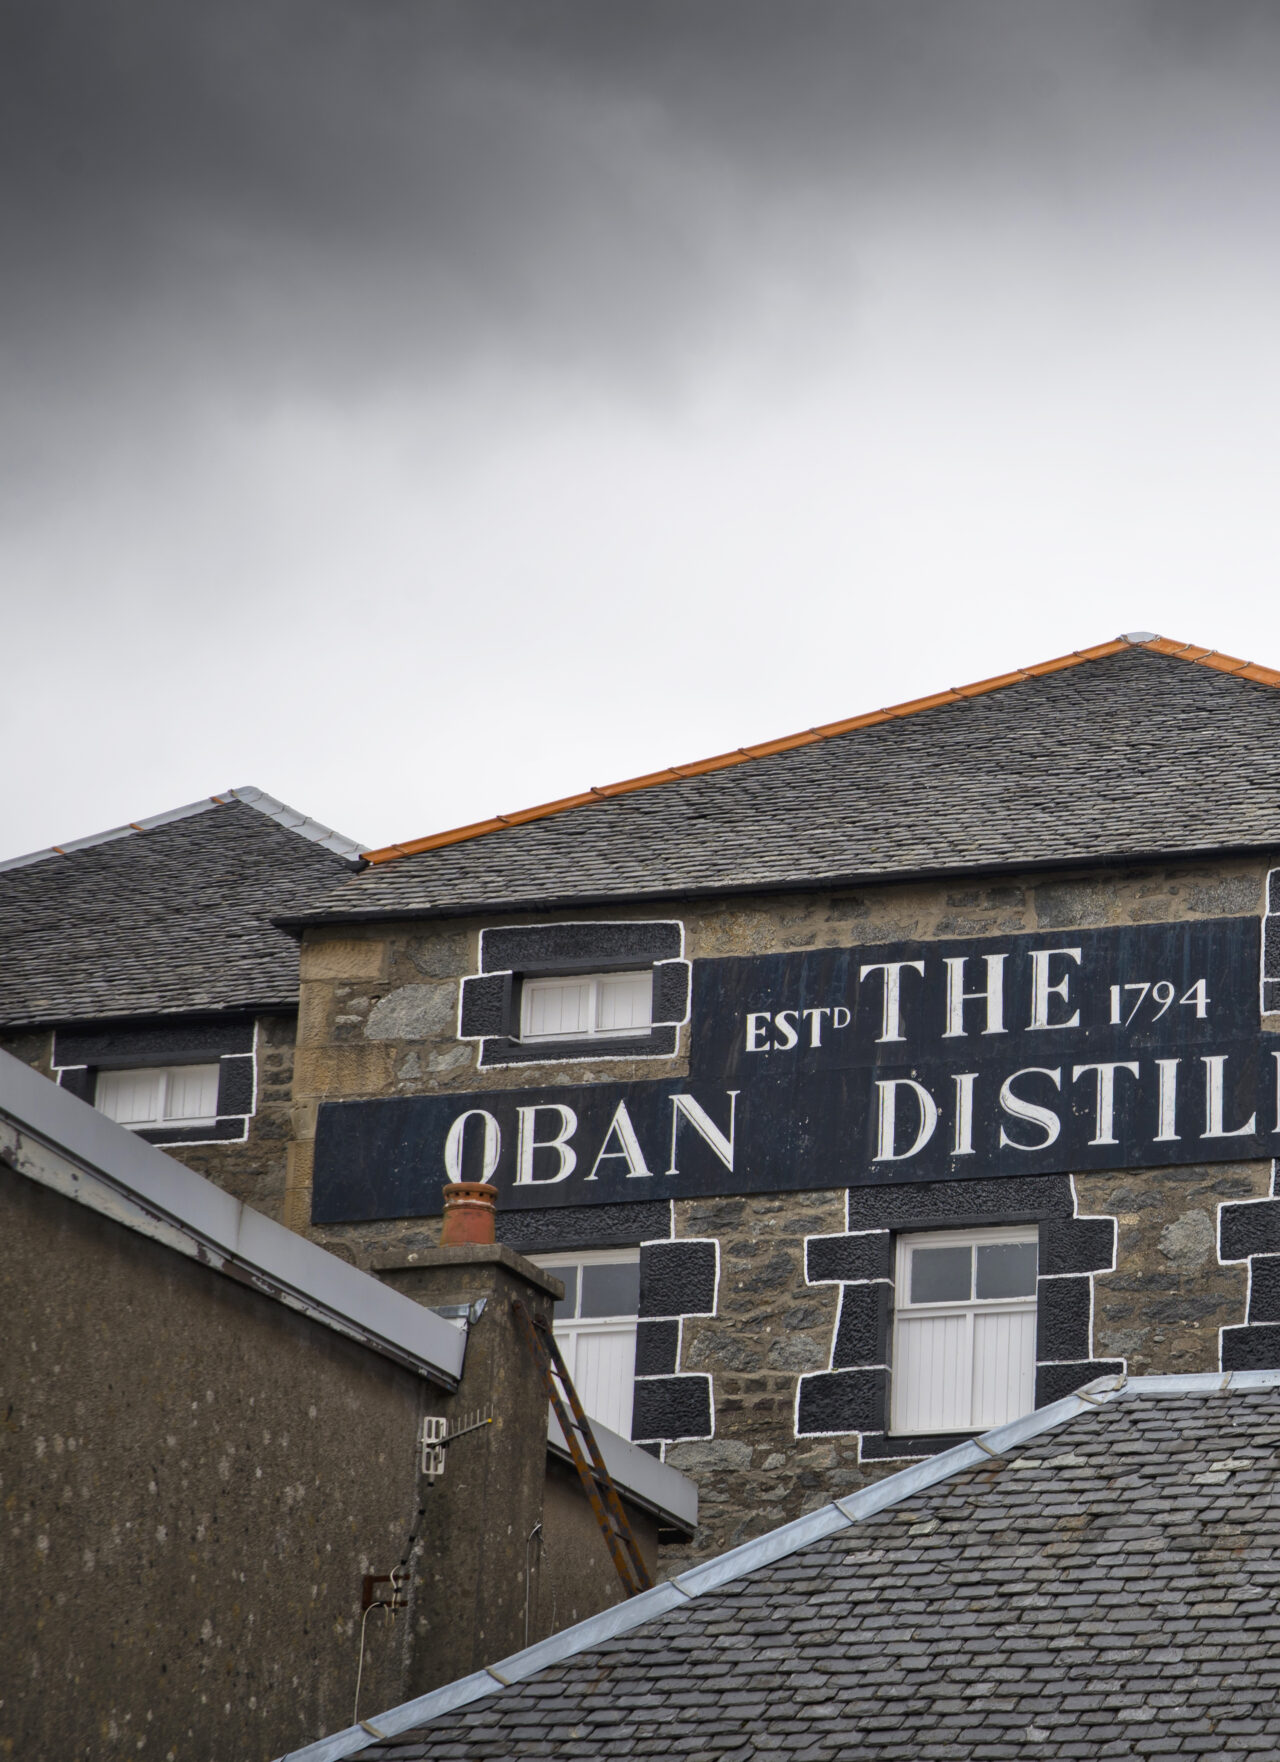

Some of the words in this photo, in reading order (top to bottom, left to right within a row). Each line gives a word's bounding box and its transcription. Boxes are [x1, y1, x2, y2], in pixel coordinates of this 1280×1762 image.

[745, 1006, 852, 1053] ESTD
[859, 947, 1083, 1044] THE
[1108, 977, 1212, 1027] 1794
[443, 1089, 741, 1187] OBAN
